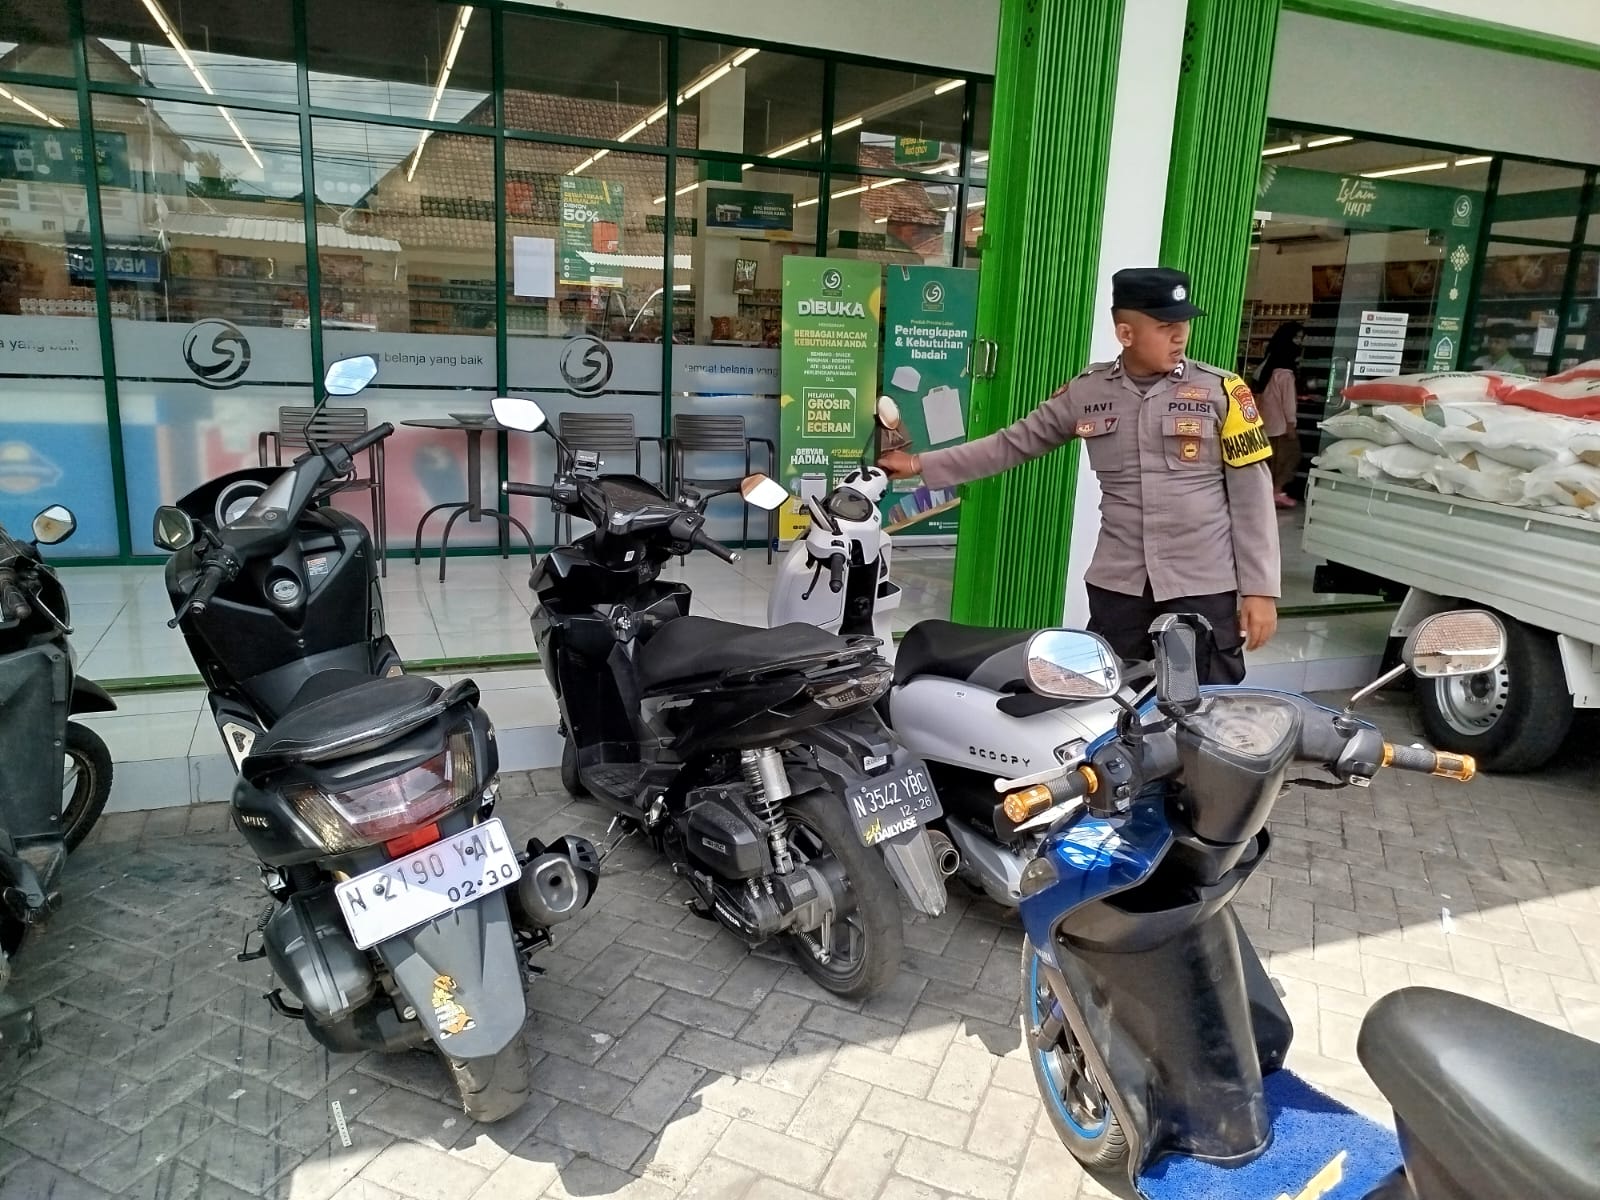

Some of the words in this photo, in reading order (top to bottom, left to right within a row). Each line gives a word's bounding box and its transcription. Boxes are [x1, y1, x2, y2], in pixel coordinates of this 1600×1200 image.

[563, 209, 599, 222] 50%
[798, 299, 866, 319] DIBUKA
[794, 329, 835, 339] BERBAGAI
[836, 331, 868, 340] MACAM
[894, 325, 968, 339] Perlengkapan
[794, 338, 842, 347] KEBUTUHAN
[843, 340, 867, 348] ANDA
[894, 337, 904, 347] &
[906, 337, 963, 349] Kebutuhan
[384, 352, 426, 366] belanja
[429, 356, 457, 366] yang
[460, 356, 484, 366] baik
[911, 349, 948, 360] Ibadah
[807, 399, 851, 410] GROSIR
[1084, 402, 1113, 414] HAVI
[1168, 402, 1211, 413] POLISI
[807, 410, 831, 421] DAN
[807, 422, 851, 433] ECERAN
[790, 455, 829, 465] HADIAH
[968, 746, 1031, 767] SCOOPY
[853, 796, 868, 818] N
[866, 783, 902, 813] 3542
[900, 772, 928, 798] YBC
[346, 888, 368, 916] N
[378, 853, 446, 902] 2190
[452, 829, 504, 867] YAL
